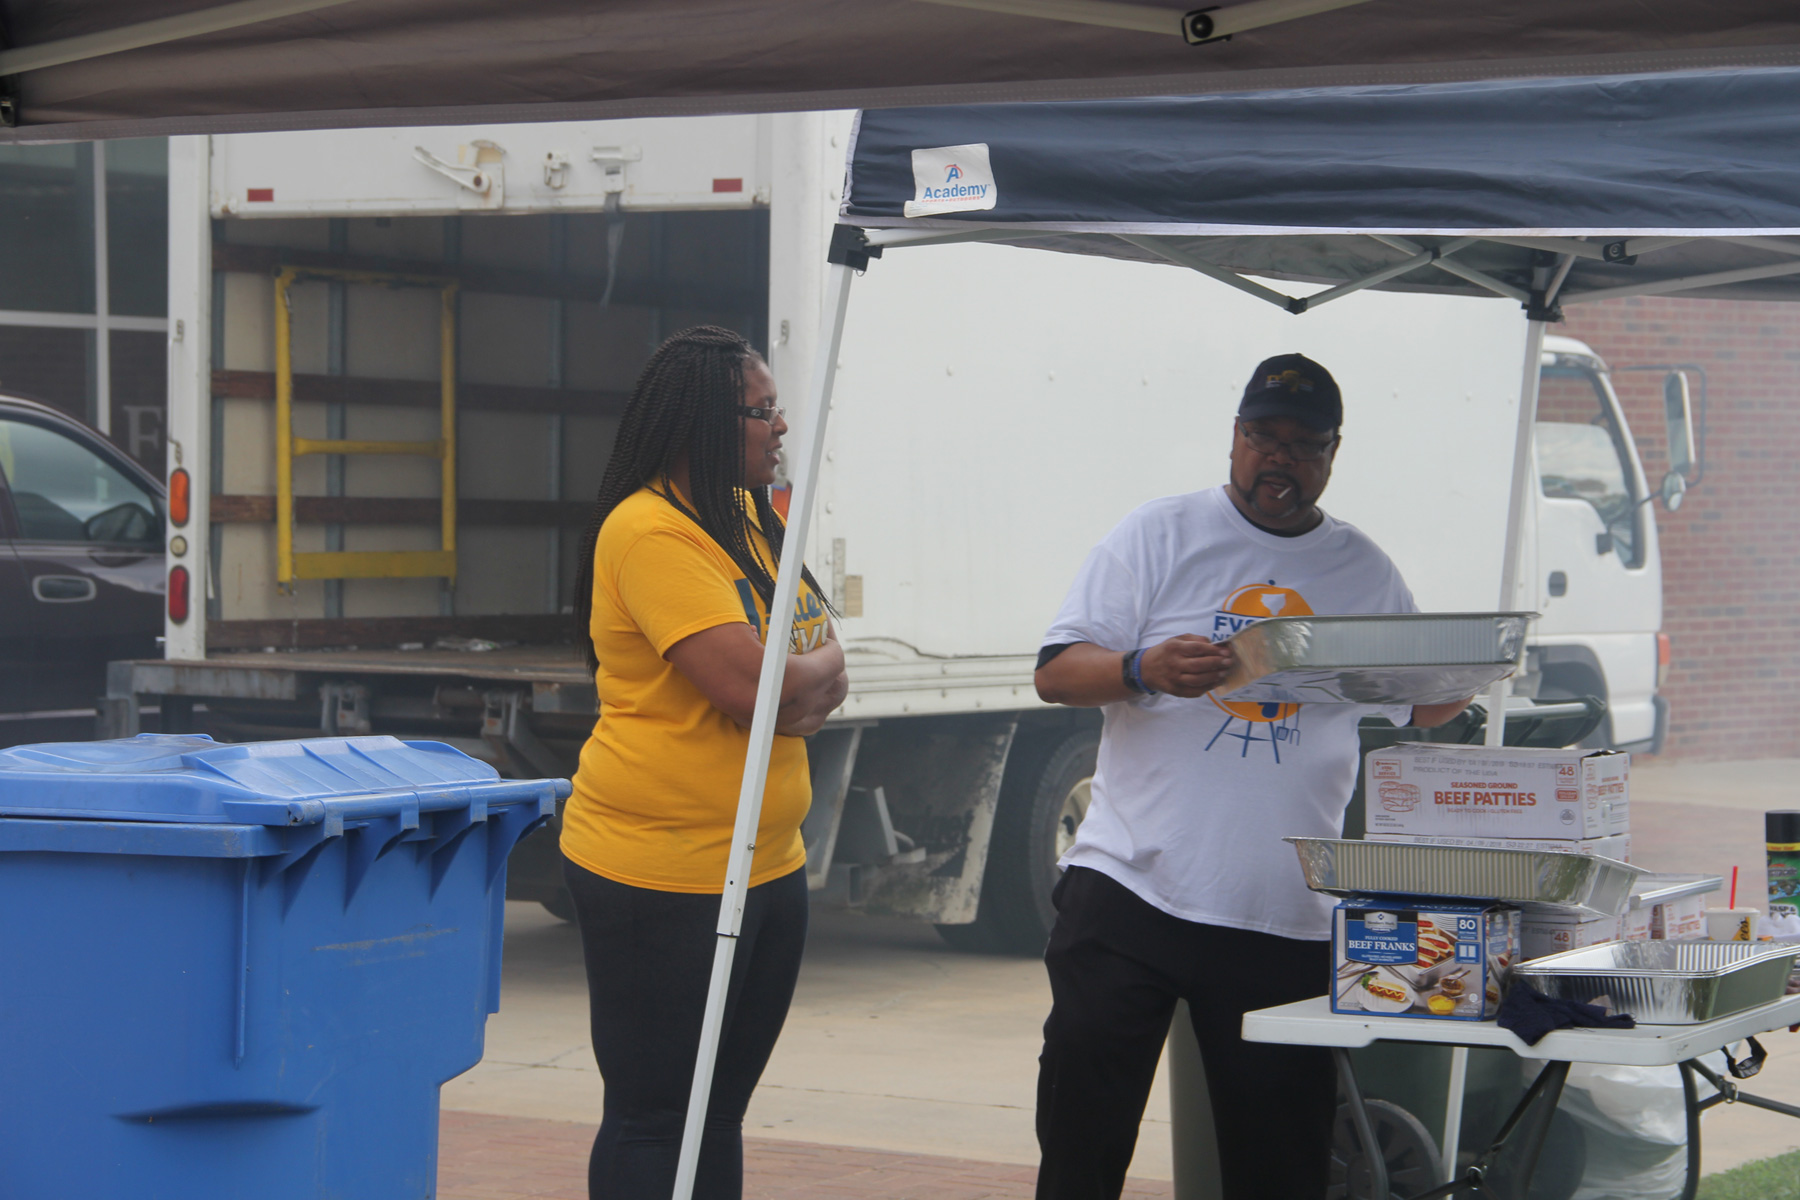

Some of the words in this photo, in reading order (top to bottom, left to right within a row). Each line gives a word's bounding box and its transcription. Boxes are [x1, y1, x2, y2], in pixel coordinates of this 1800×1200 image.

[923, 184, 987, 198] Academy
[123, 406, 162, 458] F
[1559, 766, 1574, 776] 48
[1434, 791, 1471, 805] BEEF
[1473, 792, 1537, 806] PATTIES
[1459, 919, 1476, 930] 80
[1554, 932, 1570, 942] 48
[1348, 940, 1373, 949] BEEF
[1374, 941, 1415, 951] FRANKS
